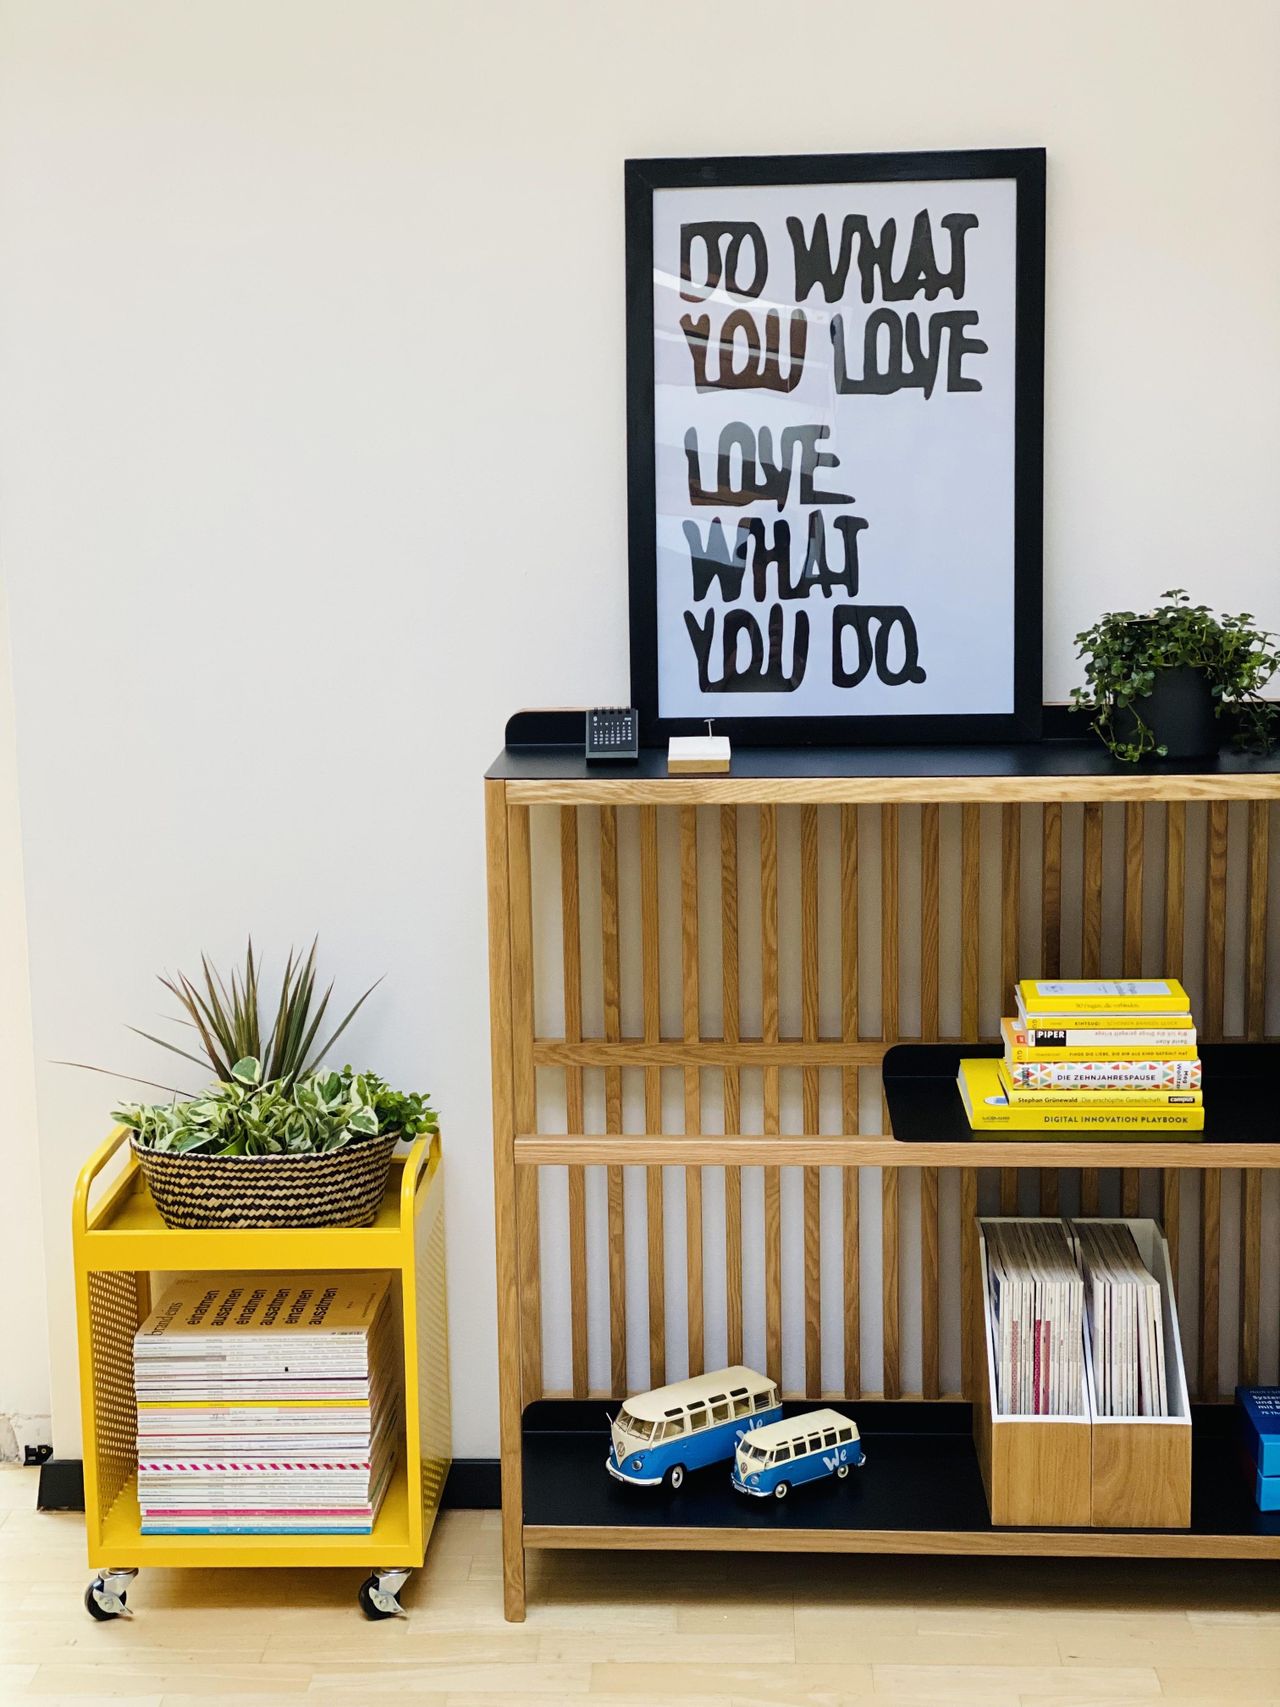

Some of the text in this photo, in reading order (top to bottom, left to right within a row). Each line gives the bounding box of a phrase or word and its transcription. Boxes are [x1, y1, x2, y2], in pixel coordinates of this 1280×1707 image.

[680, 208, 979, 303] DO WHAT
[679, 307, 989, 400] YOU LOVE
[684, 421, 856, 512] LOVE
[682, 509, 869, 602] WHAT
[683, 603, 810, 693] YOU
[1037, 1030, 1065, 1039] PIPER
[185, 1290, 220, 1325] einatmen
[210, 1288, 244, 1326] ausatmen
[234, 1289, 267, 1325] einatmen
[260, 1288, 291, 1326] ausatmen
[282, 1289, 315, 1325] einatmen
[308, 1287, 339, 1326] ausatmen
[823, 1448, 848, 1472] We
